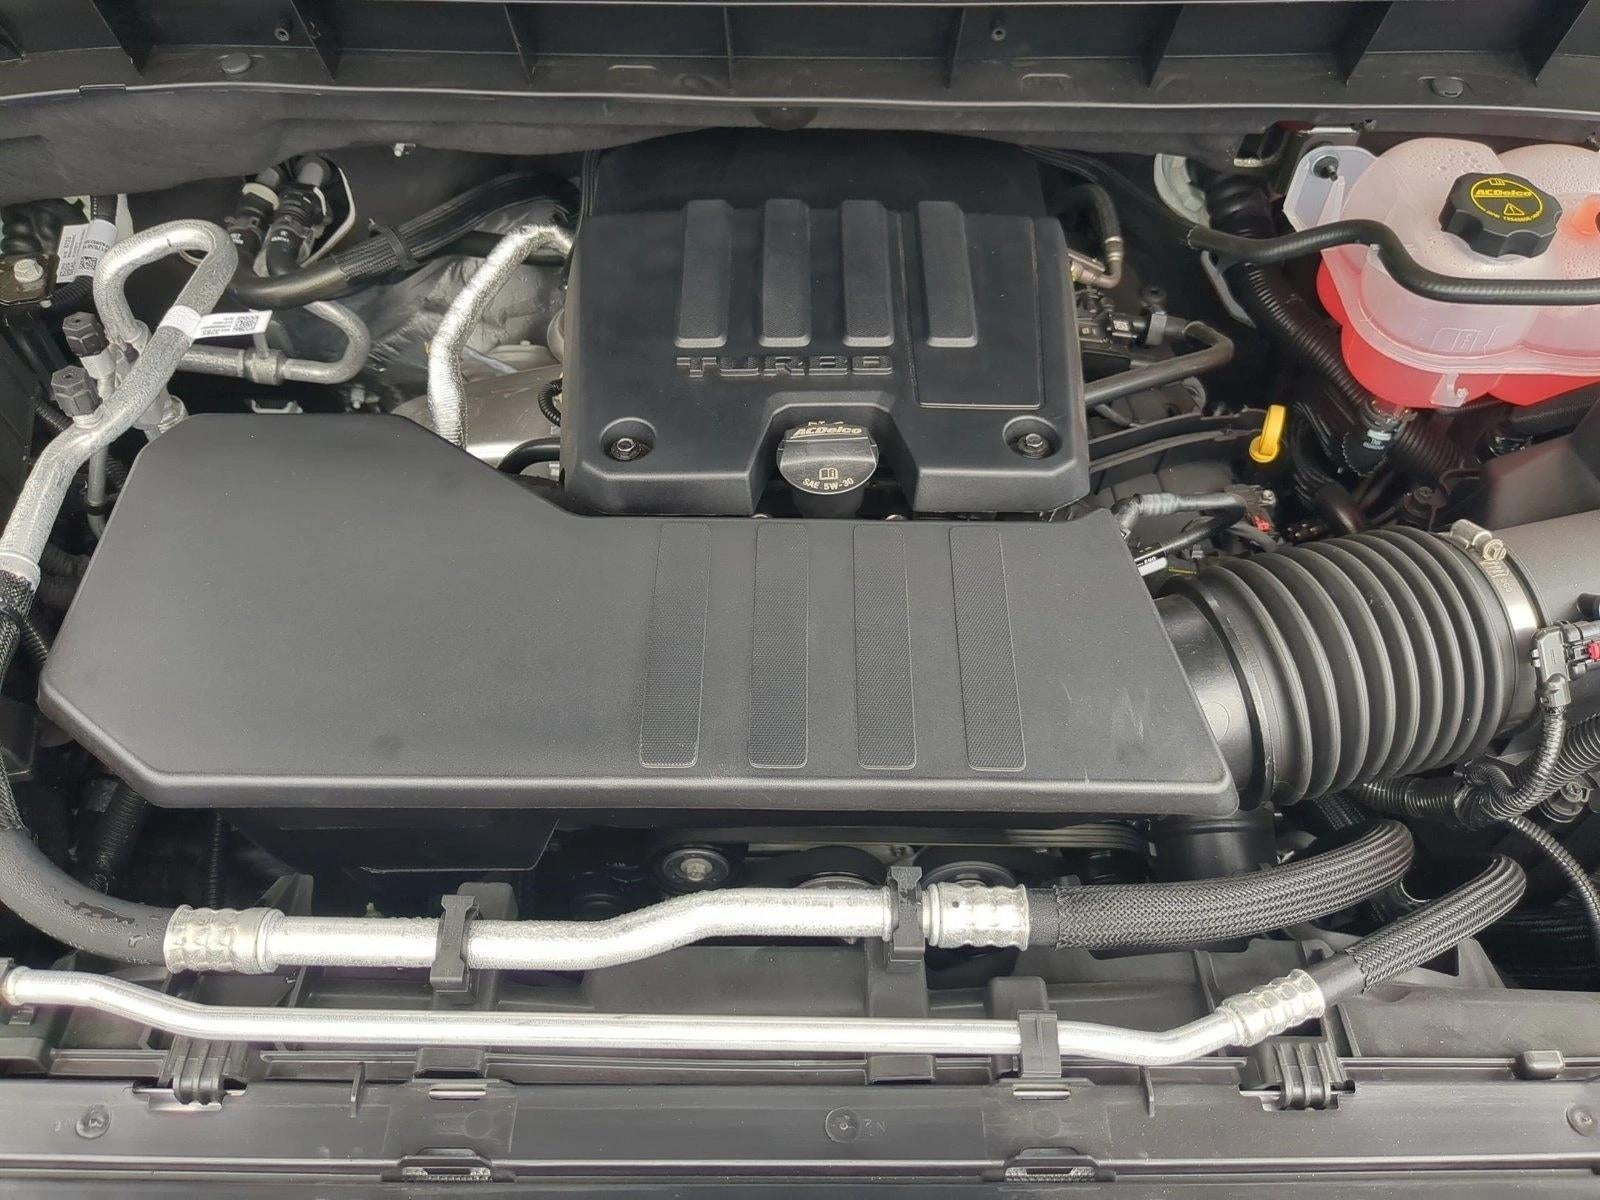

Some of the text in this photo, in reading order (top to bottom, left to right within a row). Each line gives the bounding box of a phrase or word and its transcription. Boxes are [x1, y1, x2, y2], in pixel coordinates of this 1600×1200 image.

[1475, 189, 1532, 197] ACDelco
[676, 356, 894, 378] TURBO
[791, 426, 862, 438] ACDelco
[802, 477, 854, 491] SAE 5W-30
